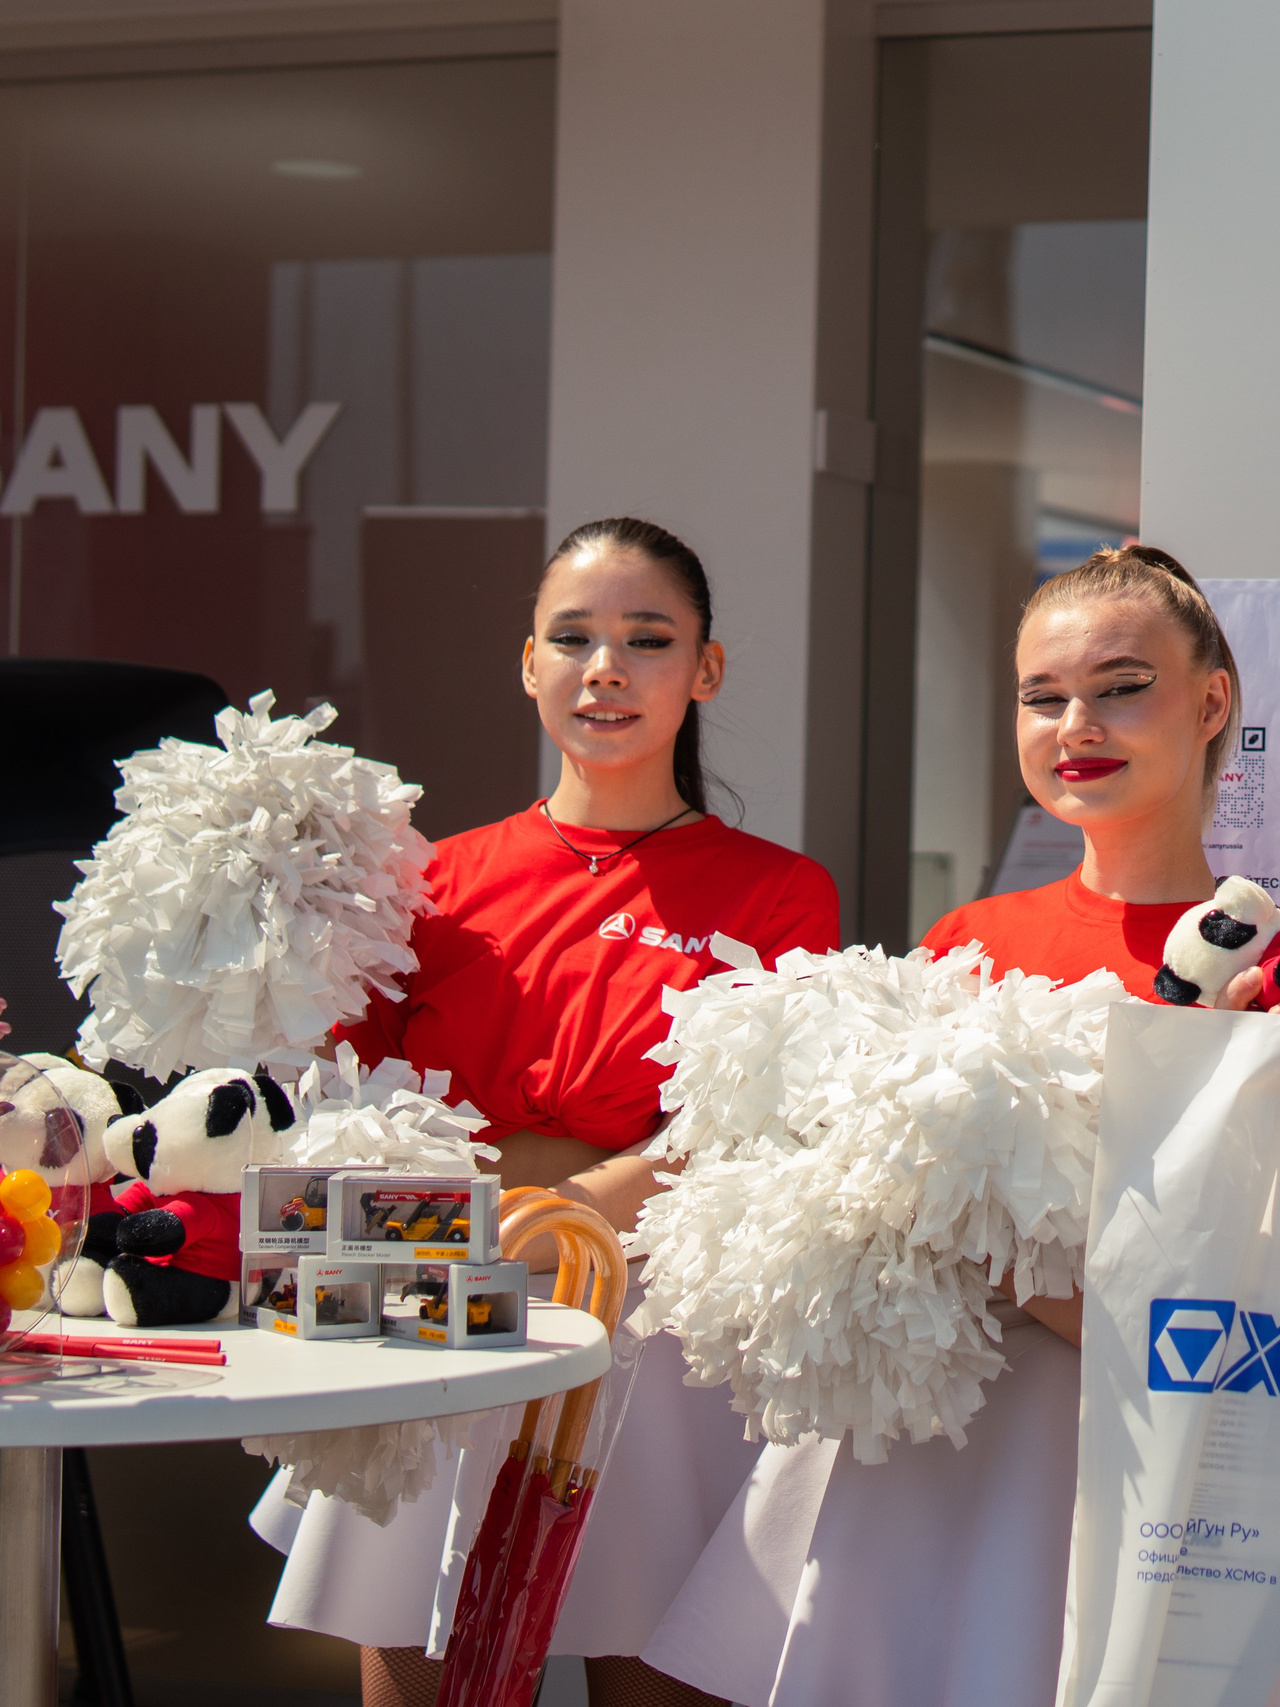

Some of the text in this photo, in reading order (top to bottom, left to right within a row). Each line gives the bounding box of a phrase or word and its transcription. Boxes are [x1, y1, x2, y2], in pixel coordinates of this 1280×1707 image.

[0, 403, 342, 515] ANY
[638, 926, 713, 954] SAN
[1140, 1522, 1184, 1539] ООО
[1225, 1568, 1266, 1584] XCMG
